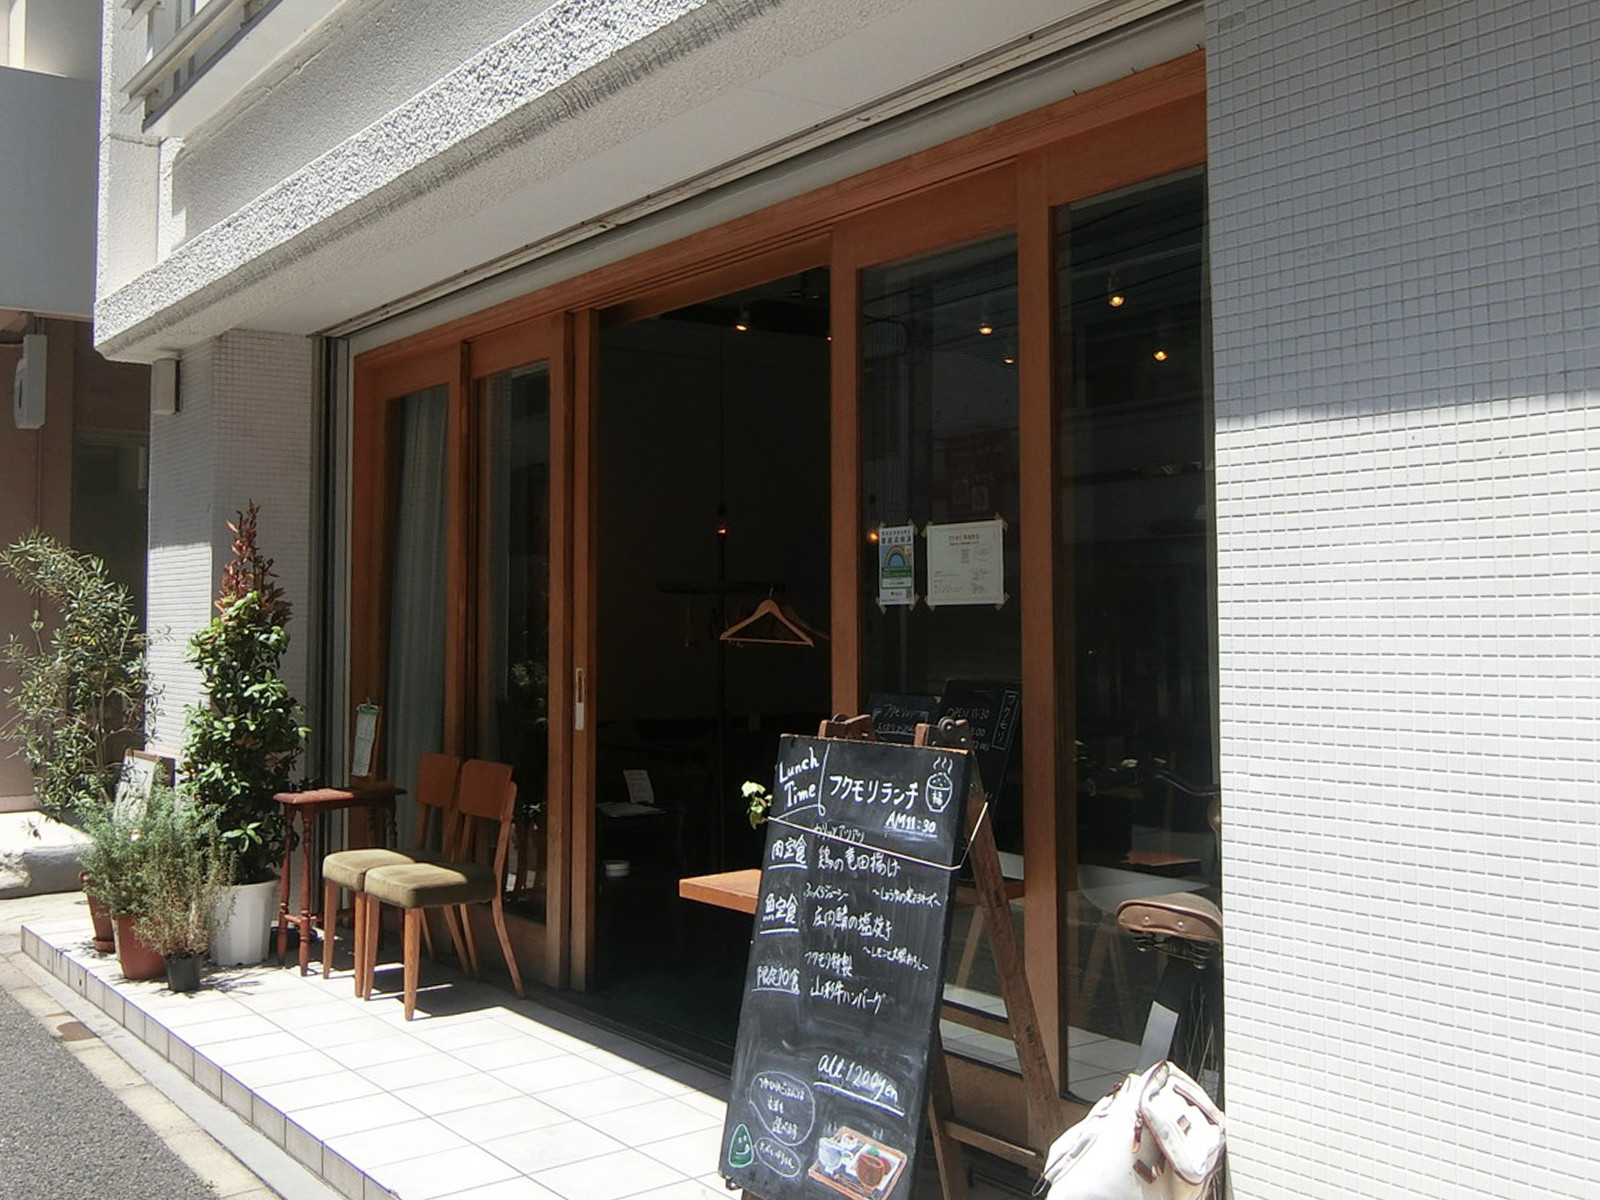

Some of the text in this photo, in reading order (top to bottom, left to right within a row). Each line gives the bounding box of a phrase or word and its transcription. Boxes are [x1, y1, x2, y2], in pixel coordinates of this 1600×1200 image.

[778, 746, 820, 782] Lunch
[783, 779, 817, 809] Time
[829, 775, 919, 811] フクモリランチ
[884, 810, 937, 834] AM11:30
